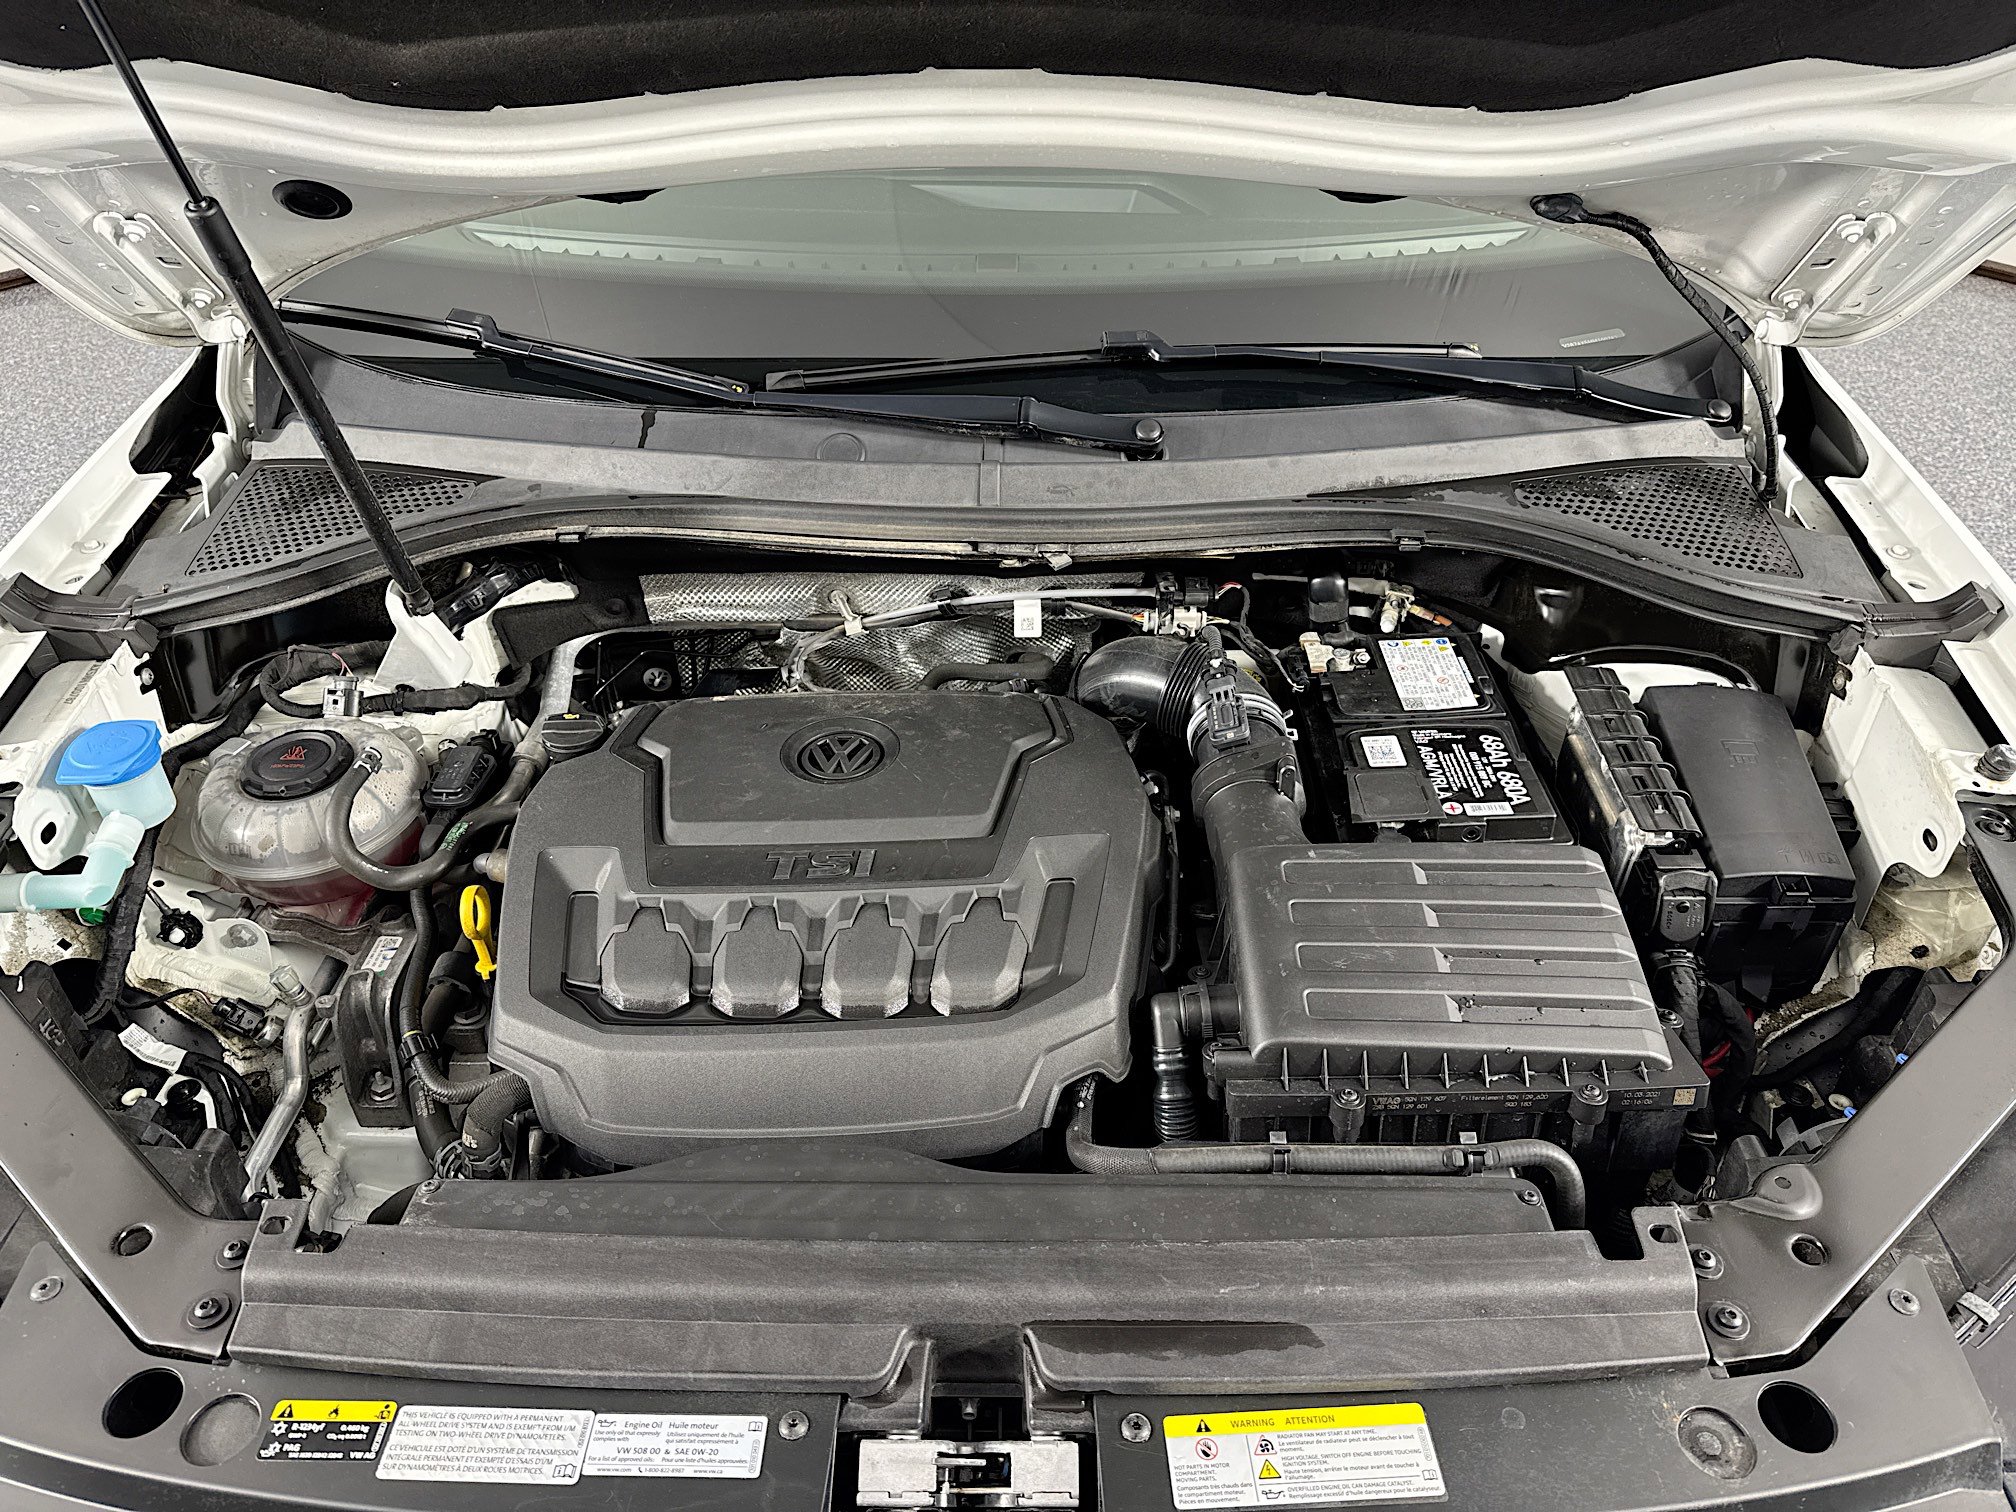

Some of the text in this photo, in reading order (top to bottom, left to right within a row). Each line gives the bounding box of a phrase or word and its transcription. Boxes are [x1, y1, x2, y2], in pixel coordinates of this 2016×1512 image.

[803, 735, 880, 778] VW
[1417, 745, 1453, 800] AGM/VRLA
[1478, 734, 1512, 768] 68Ah
[1496, 771, 1532, 806] 680A
[766, 848, 877, 879] TSI
[418, 1411, 447, 1419] VEHICLE
[456, 1412, 493, 1420] EQUIPPED
[519, 1414, 564, 1422] PERMANENT
[1230, 1414, 1336, 1428] WARNING ATTENTION
[623, 1422, 650, 1430] Engine
[506, 1432, 567, 1440] DYNAMOMETERS.
[527, 1448, 579, 1456] TRANSMISSION
[1177, 1484, 1209, 1492] Composants
[1288, 1492, 1322, 1500] Remplissage
[1364, 1488, 1392, 1496] dangereux
